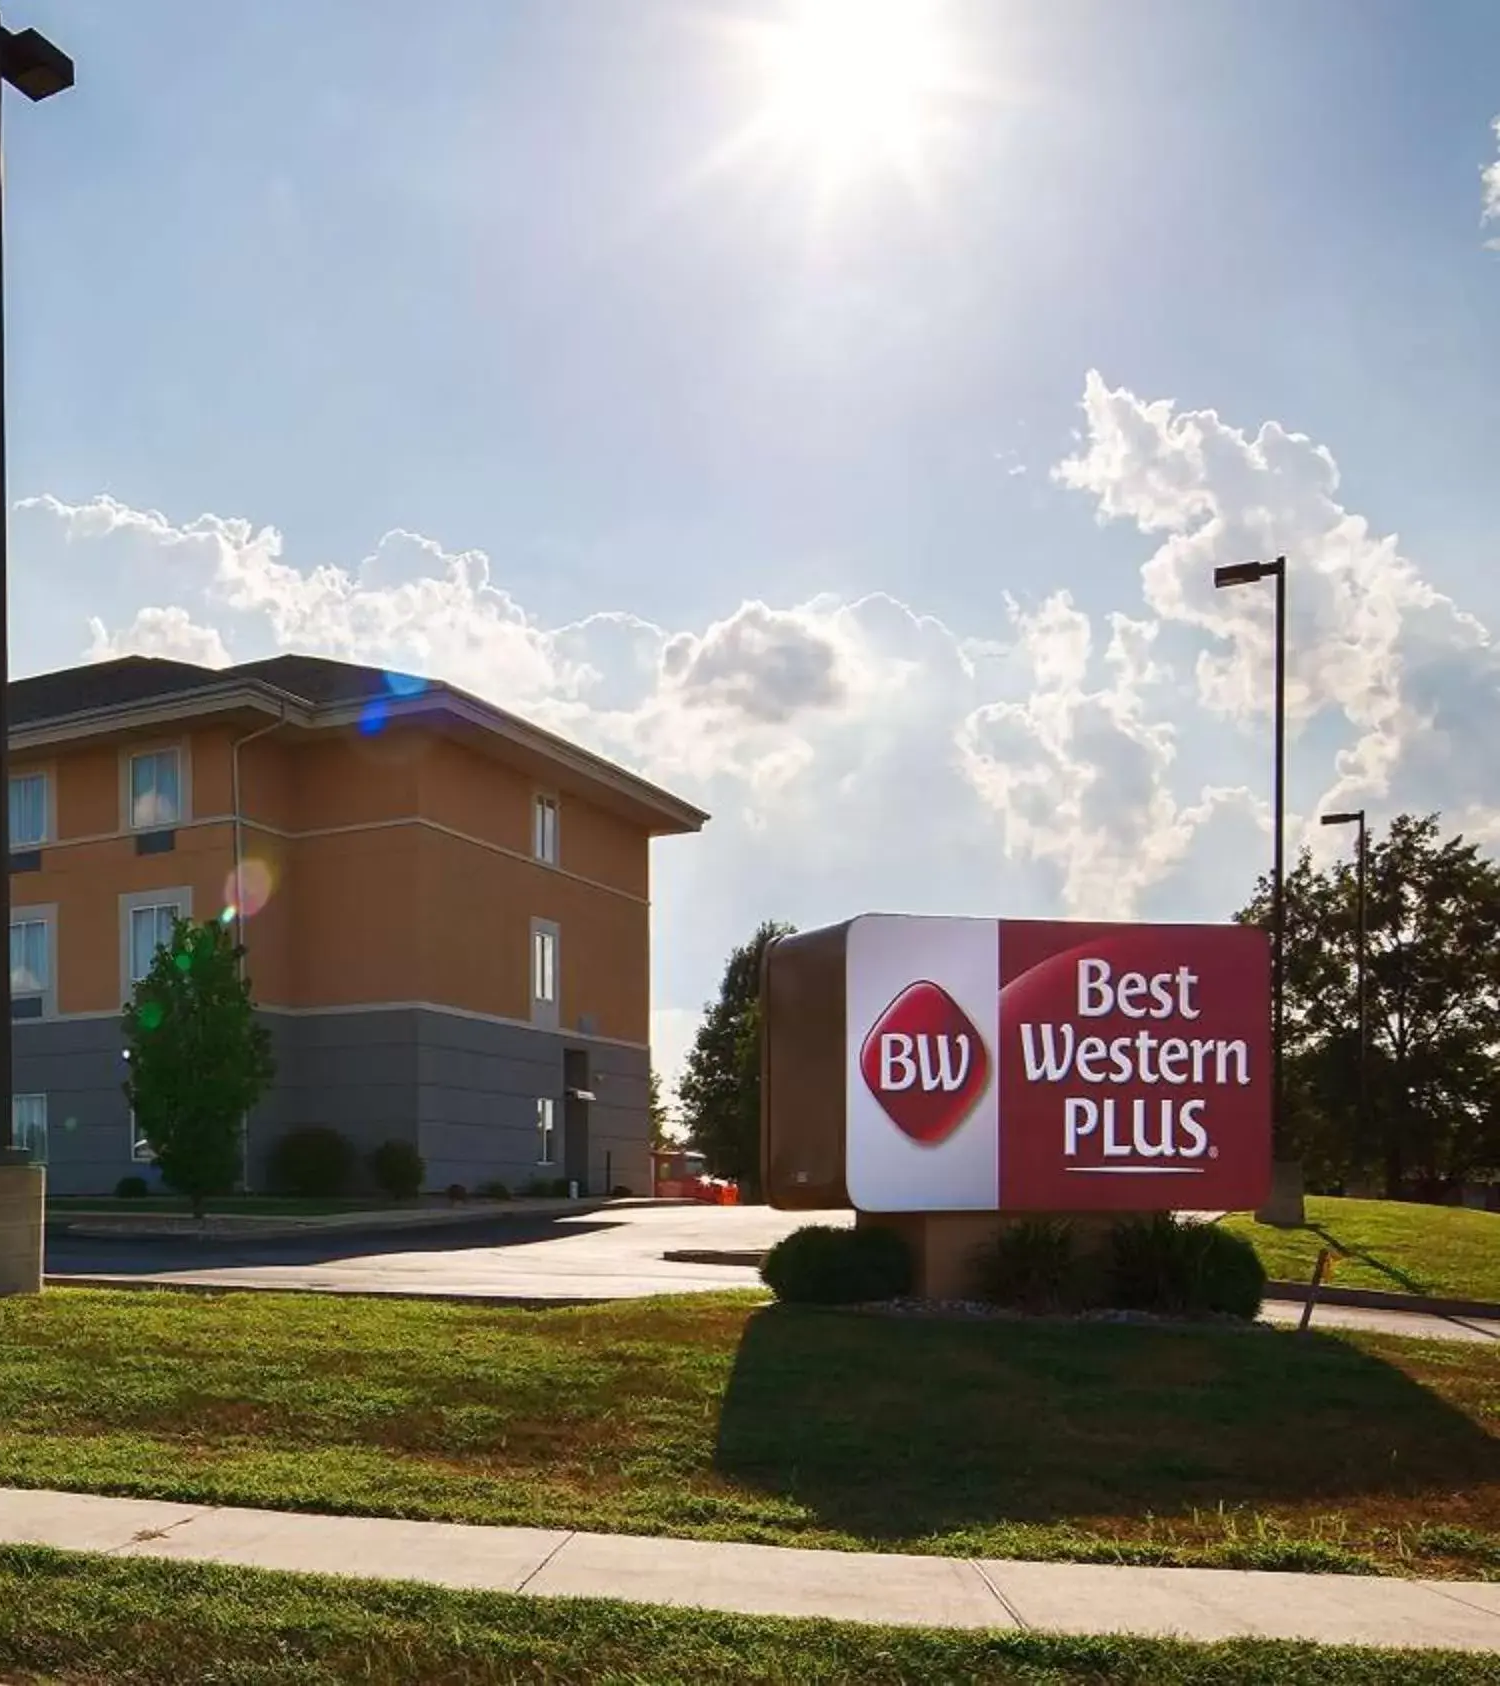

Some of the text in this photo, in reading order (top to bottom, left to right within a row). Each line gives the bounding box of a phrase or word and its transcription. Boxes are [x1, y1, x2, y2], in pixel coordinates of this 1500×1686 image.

[1077, 958, 1201, 1020] Best
[880, 1032, 970, 1092] BW
[1020, 1023, 1251, 1085] Western
